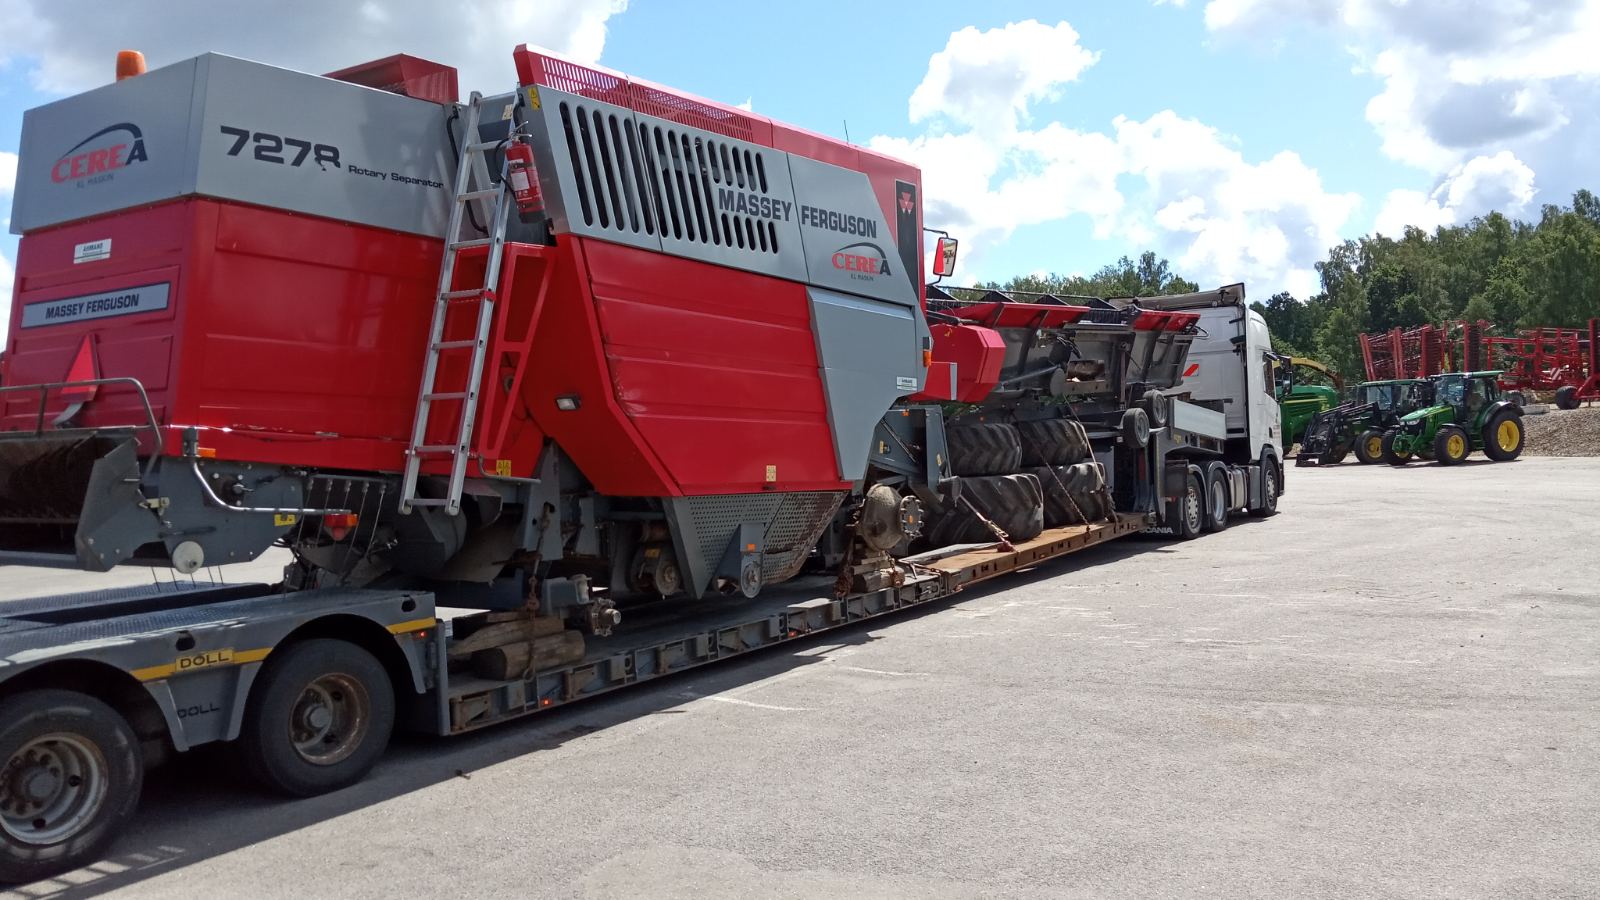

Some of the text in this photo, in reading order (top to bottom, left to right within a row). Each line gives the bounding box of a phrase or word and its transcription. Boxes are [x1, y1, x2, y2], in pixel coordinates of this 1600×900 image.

[220, 125, 341, 171] 7278
[51, 139, 148, 184] CEREA
[349, 165, 444, 189] Rotary Separator
[719, 188, 877, 238] MASSEY FERGUSON
[832, 253, 891, 276] CEREA
[46, 294, 139, 319] MASSEY FERGUSON
[180, 652, 229, 669] DOLL
[177, 702, 220, 718] DOLL
